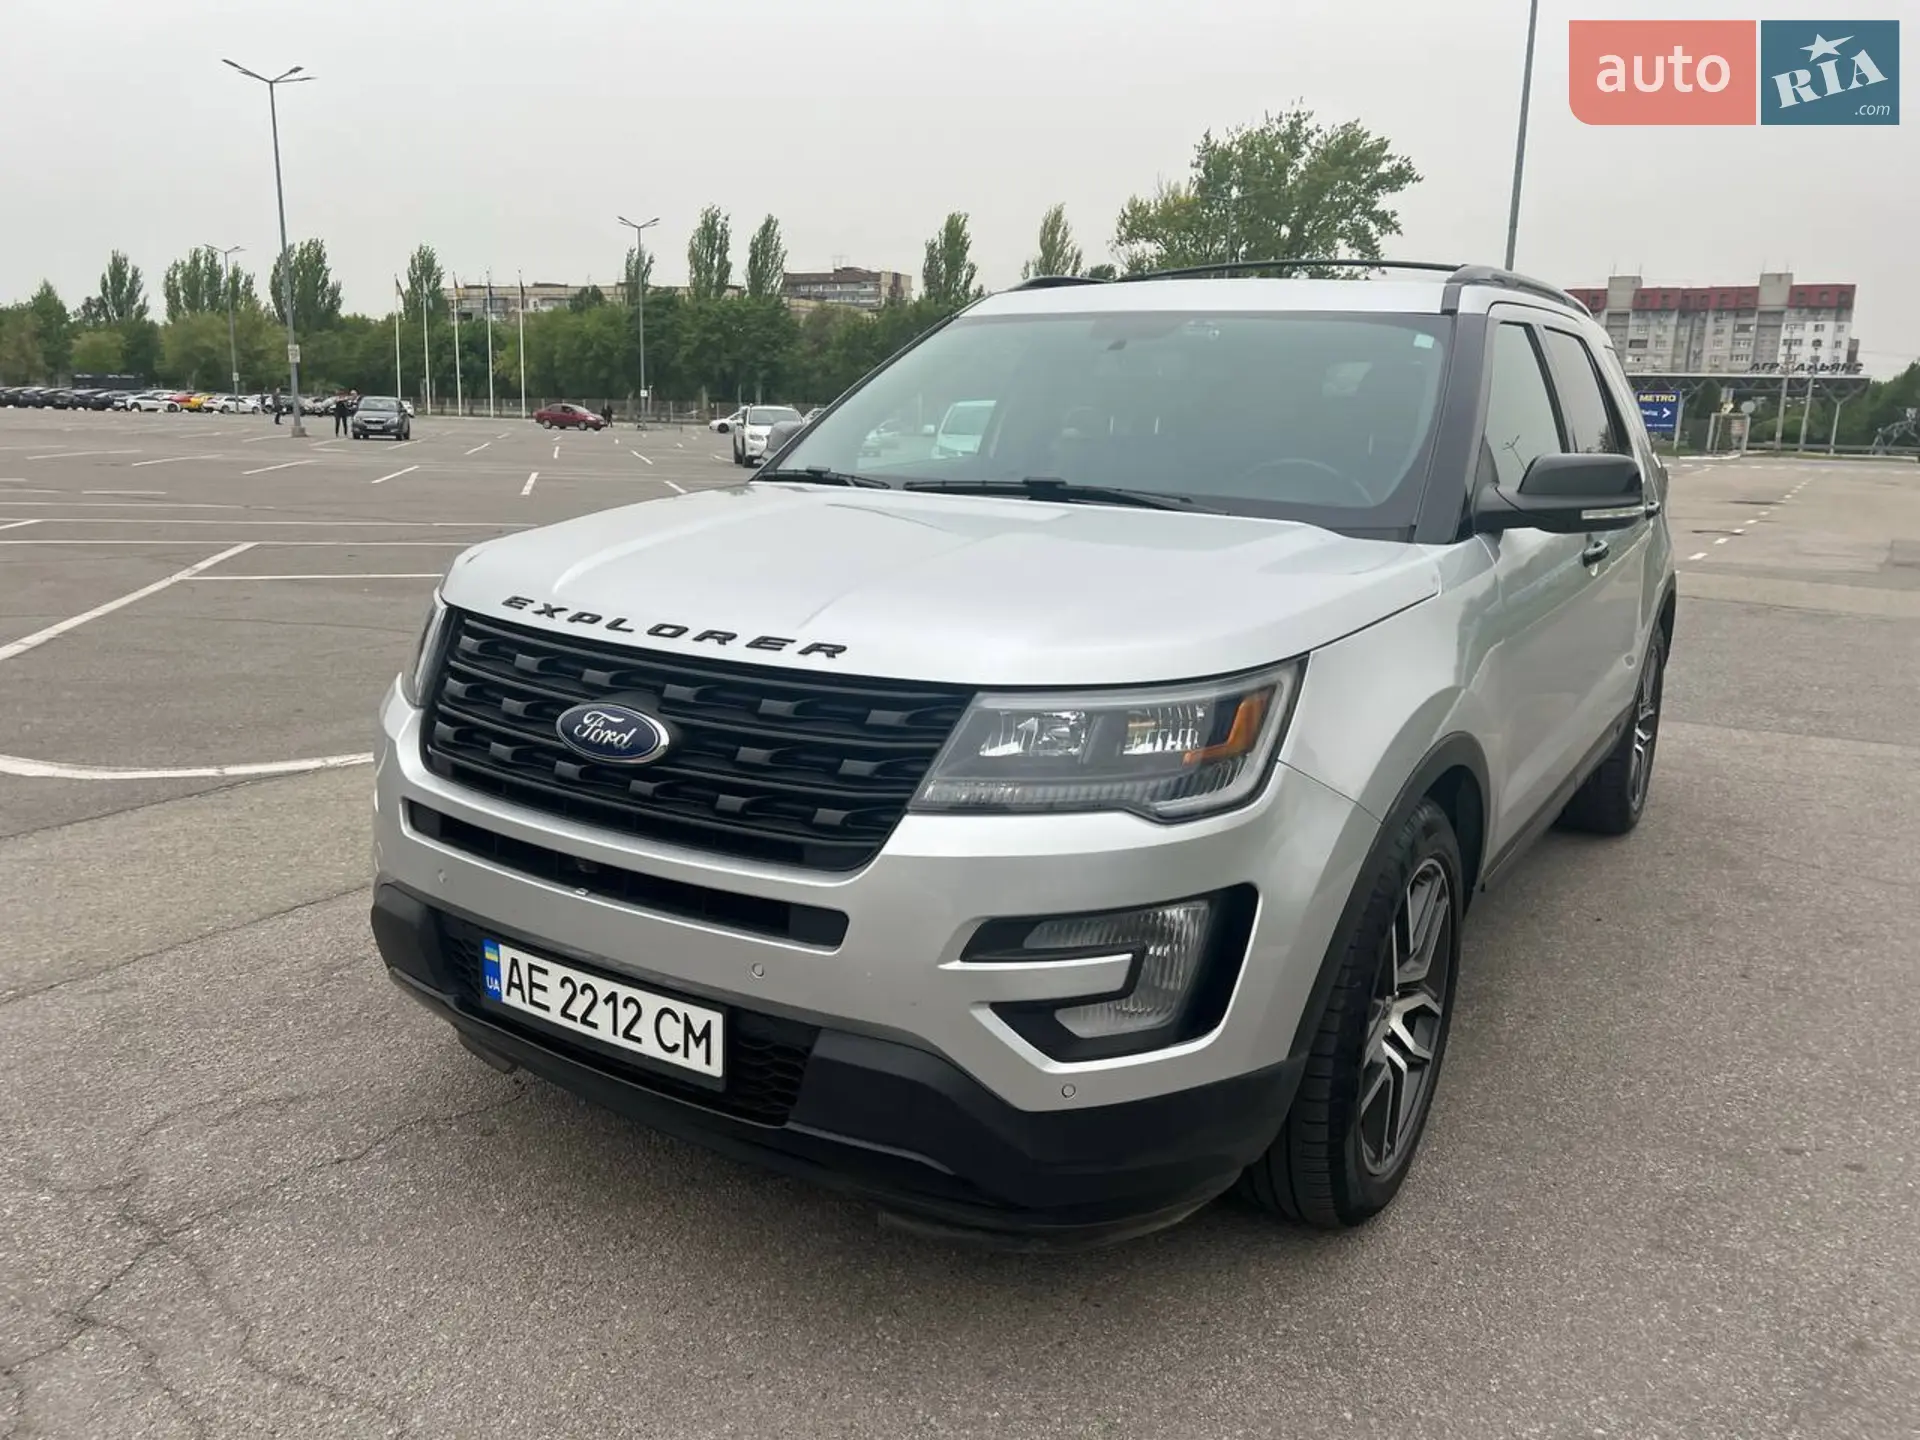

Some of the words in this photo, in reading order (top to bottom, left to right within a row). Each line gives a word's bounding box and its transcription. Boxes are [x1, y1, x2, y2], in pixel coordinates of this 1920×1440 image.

[1639, 394, 1677, 403] METRO
[502, 596, 848, 659] EXPLORER
[574, 710, 637, 750] Ford
[486, 975, 500, 992] UA
[506, 957, 551, 1013] AE
[560, 976, 643, 1045] 2212
[654, 1007, 712, 1066] CM
